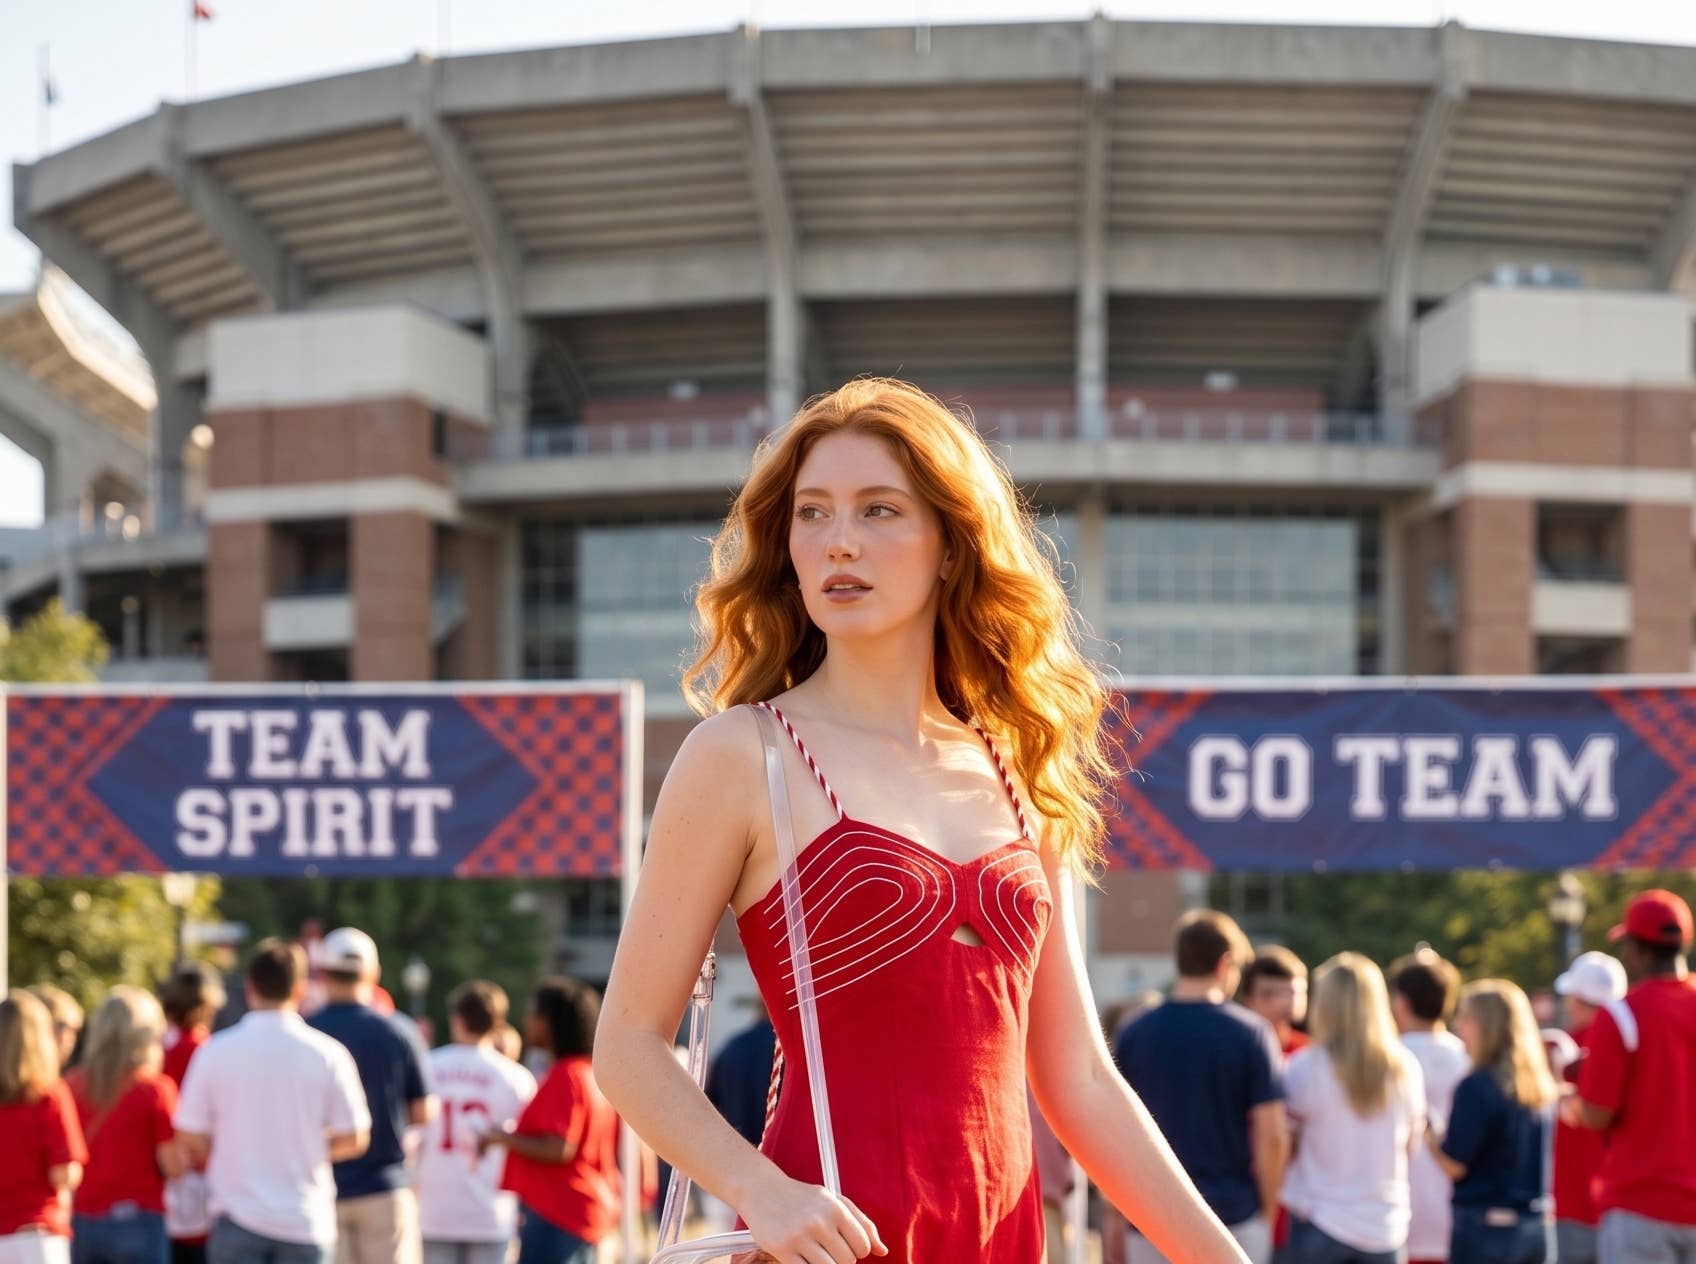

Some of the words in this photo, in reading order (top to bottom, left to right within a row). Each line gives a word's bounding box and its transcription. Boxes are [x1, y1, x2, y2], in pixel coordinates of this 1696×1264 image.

[192, 709, 431, 779] TEAM
[1189, 736, 1312, 820] GO
[1334, 735, 1617, 819] TEAM
[175, 788, 454, 858] SPIRIT
